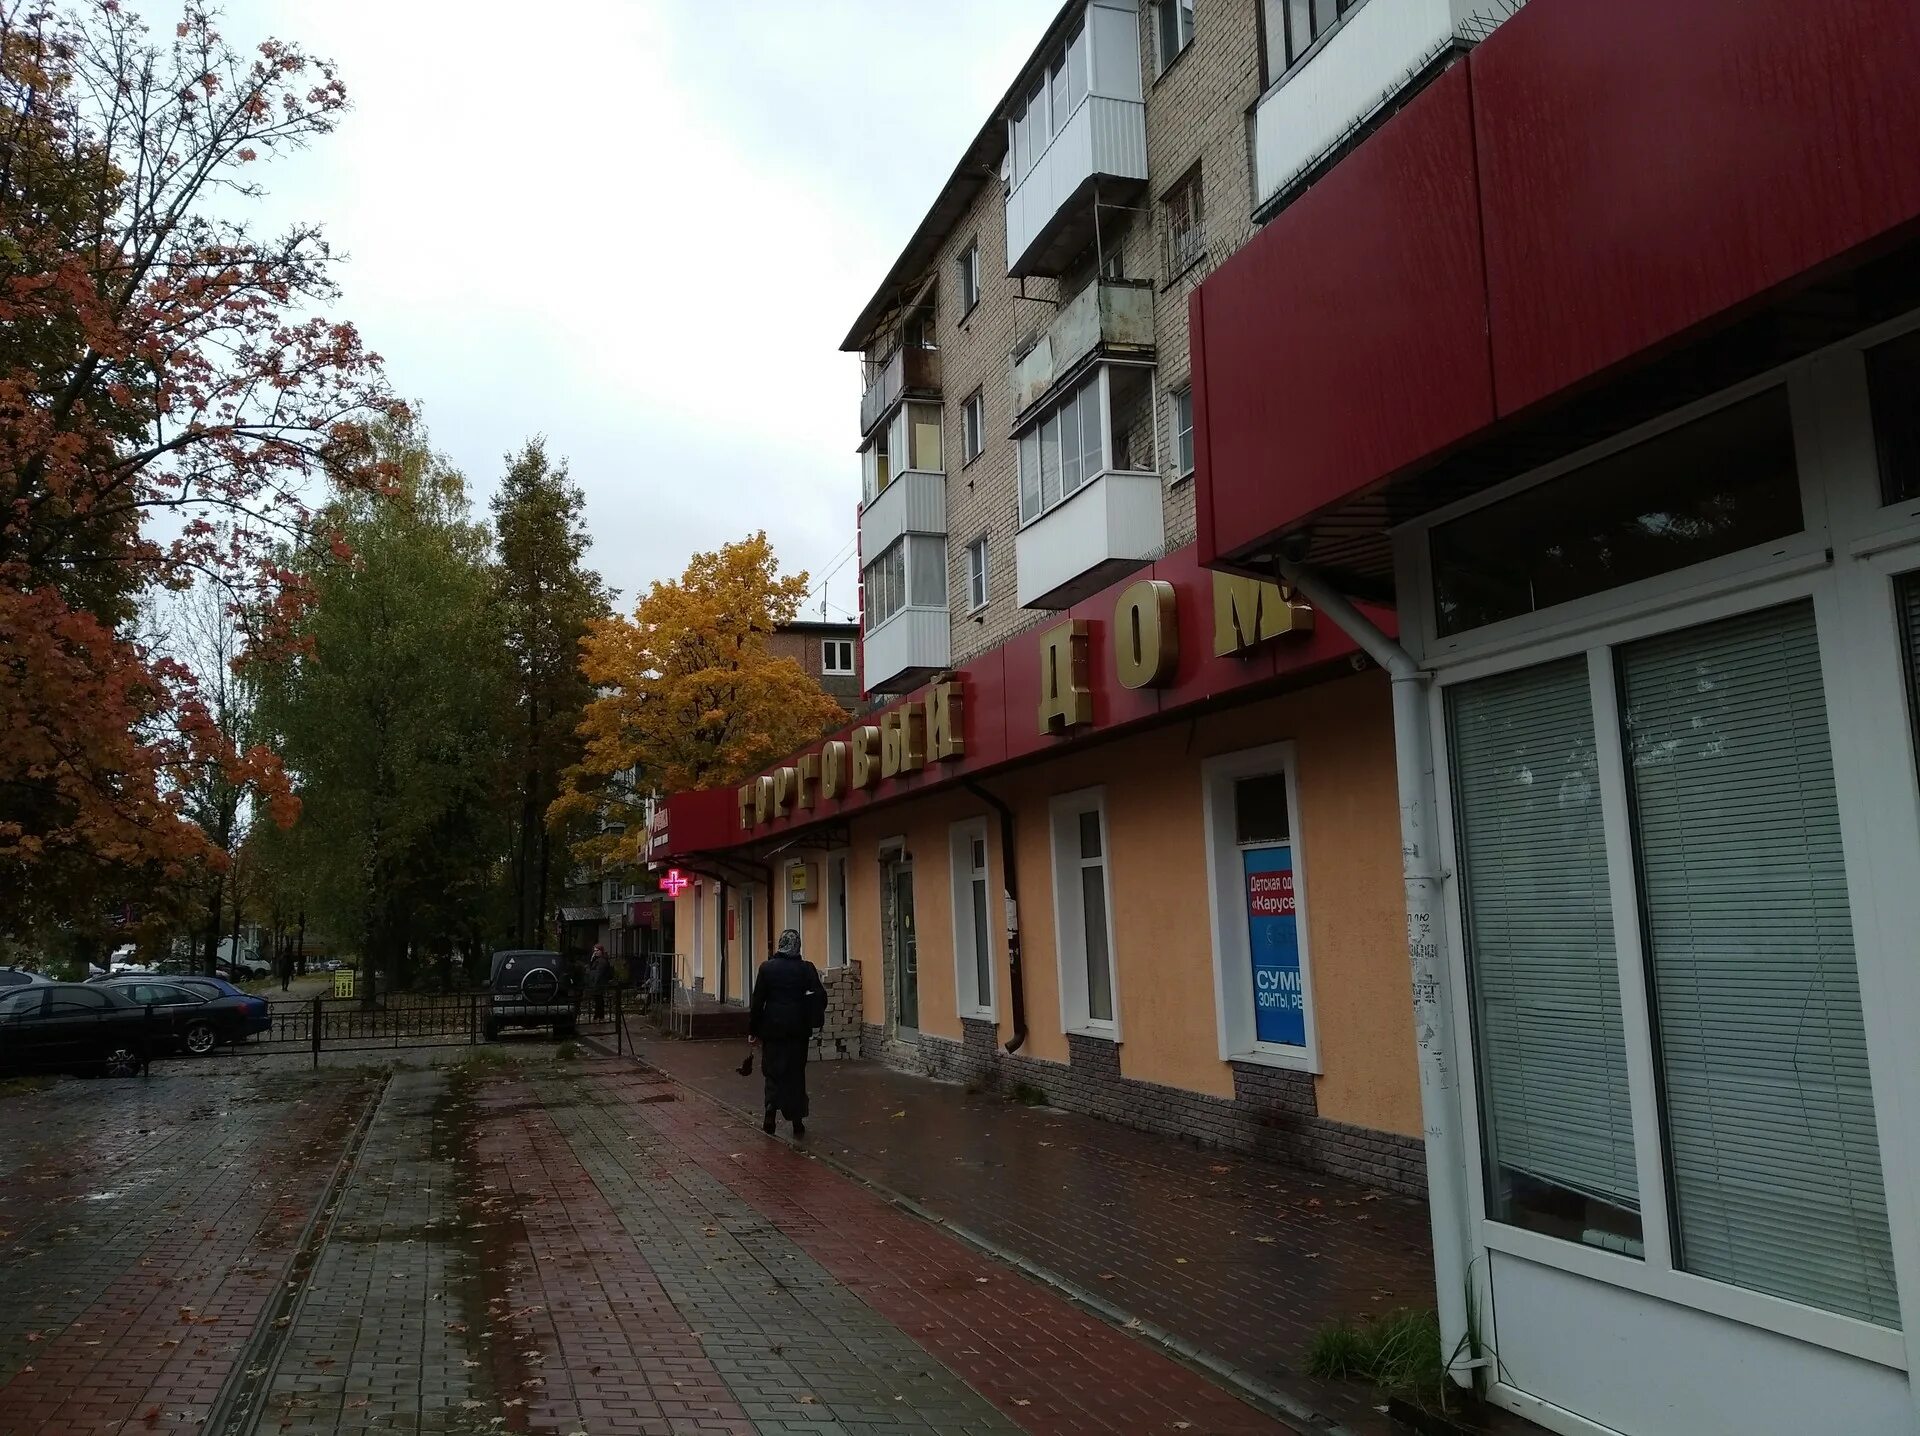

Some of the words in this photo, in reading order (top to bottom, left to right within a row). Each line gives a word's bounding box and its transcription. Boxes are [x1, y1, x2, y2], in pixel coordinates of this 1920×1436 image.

[738, 670, 964, 830] ТОРГОВЫЙ
[1039, 569, 1313, 736] ДОМ
[1250, 876, 1281, 892] Детская
[1251, 895, 1296, 913] «Карусе
[1258, 991, 1290, 1011] ЗОНТЫ,
